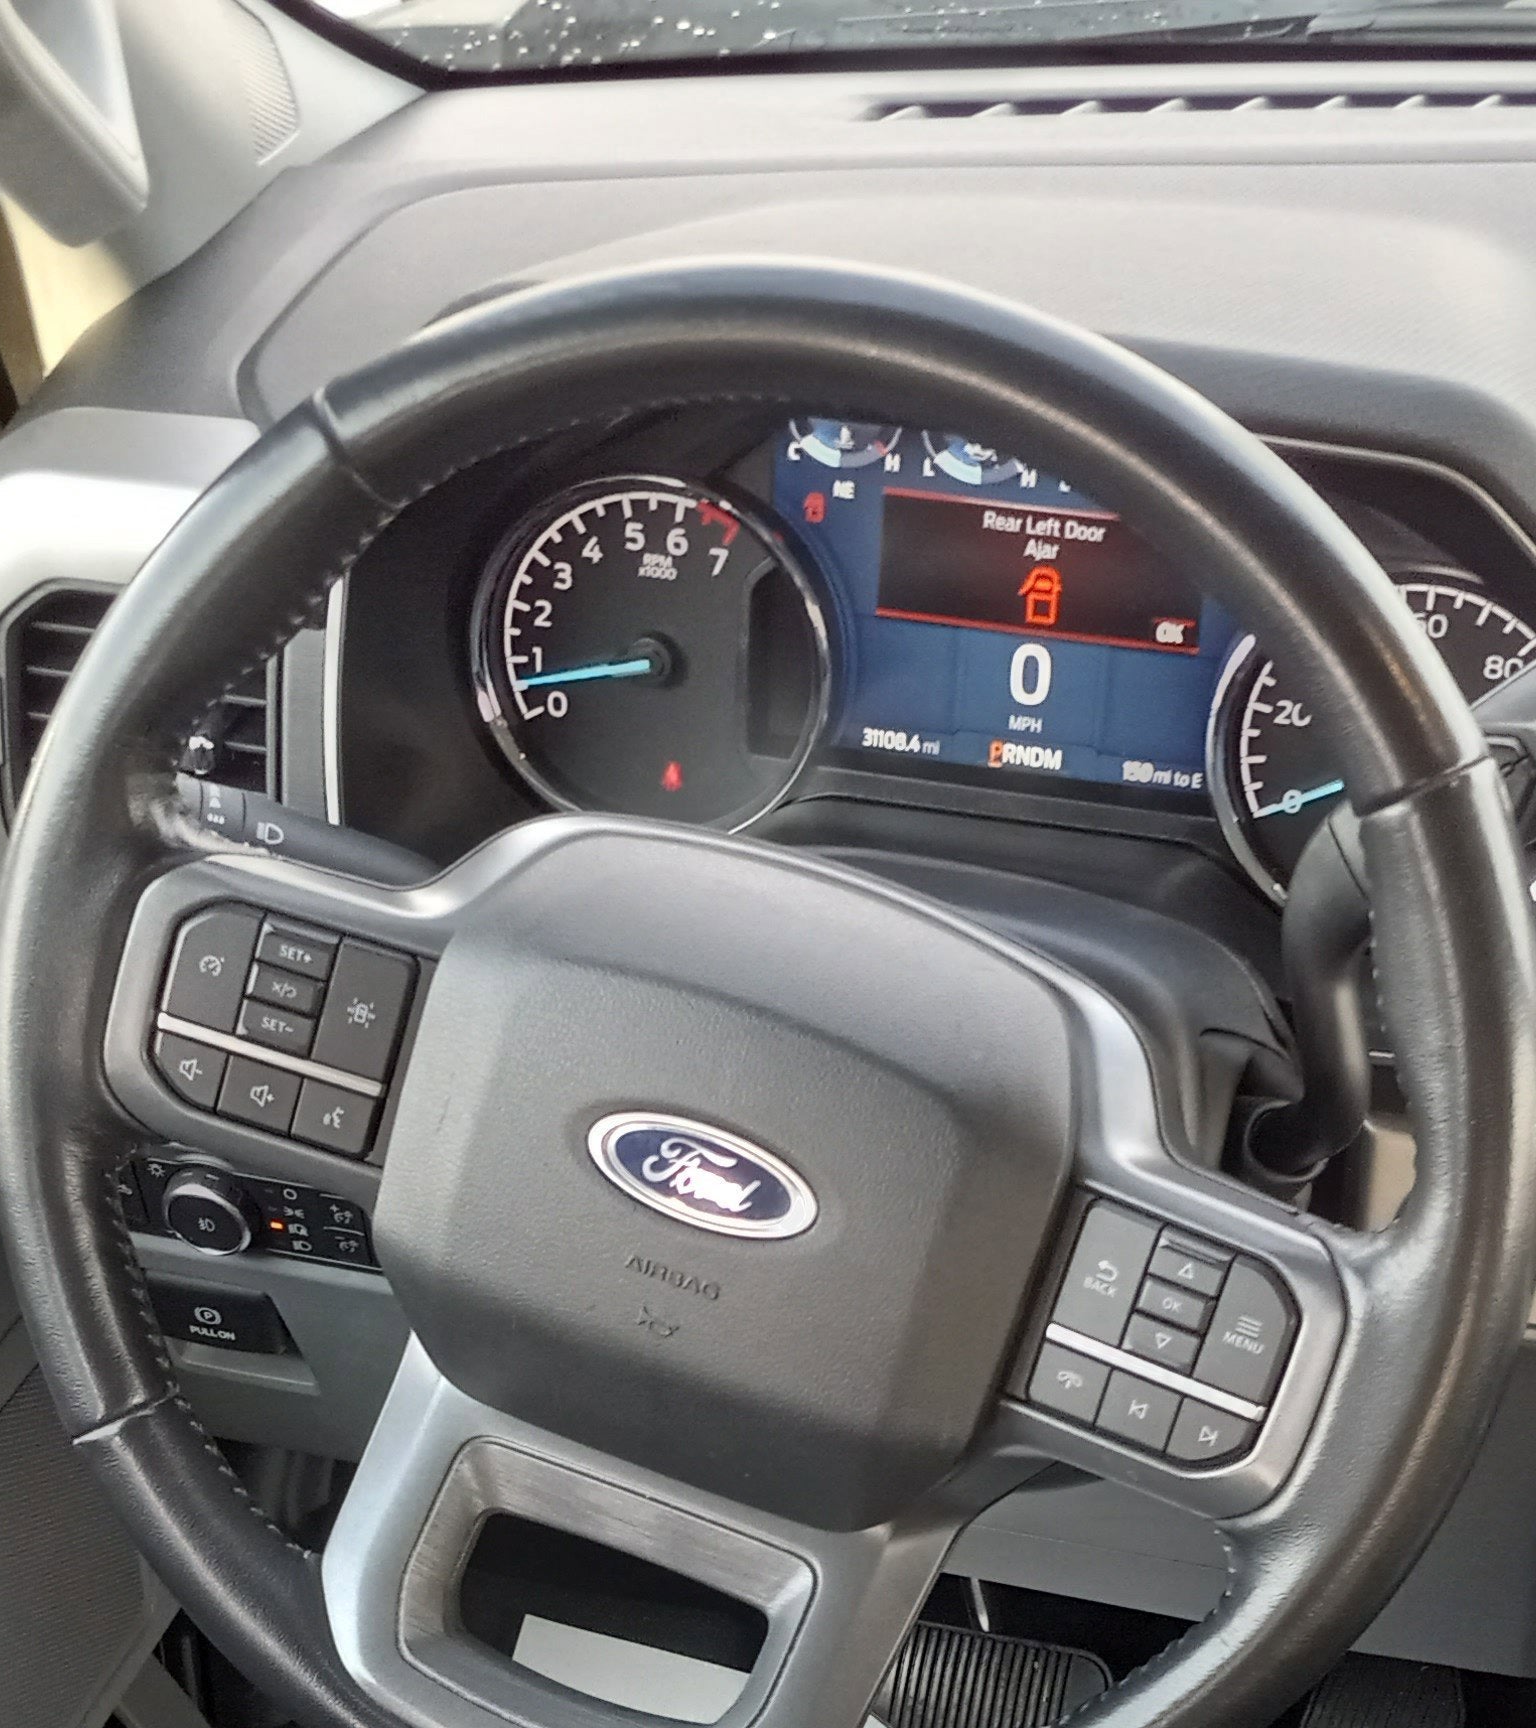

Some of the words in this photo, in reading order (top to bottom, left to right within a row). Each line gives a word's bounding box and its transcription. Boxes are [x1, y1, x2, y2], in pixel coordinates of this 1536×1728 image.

[624, 522, 646, 551] 5
[983, 511, 1022, 534] Rear
[1025, 515, 1061, 538] Left
[1064, 521, 1106, 543] Door
[581, 536, 604, 564] 4
[666, 528, 689, 556] 6
[1024, 539, 1060, 561] Ajar
[642, 552, 673, 568] RPM
[708, 548, 729, 577] 7
[552, 562, 573, 590] 3
[533, 600, 553, 628] 2
[1155, 621, 1185, 644] OK
[531, 646, 543, 673] 1
[1009, 643, 1052, 706] 0
[546, 690, 568, 718] 0
[1008, 715, 1043, 733] MPH
[922, 739, 940, 756] mi
[1174, 770, 1191, 787] to
[1192, 772, 1204, 789] E
[642, 1137, 761, 1212] Ford
[1083, 1274, 1118, 1298] BACK
[1162, 1297, 1183, 1312] OK
[190, 1326, 215, 1337] PULL
[217, 1331, 235, 1340] ON
[1222, 1331, 1265, 1355] MENU
